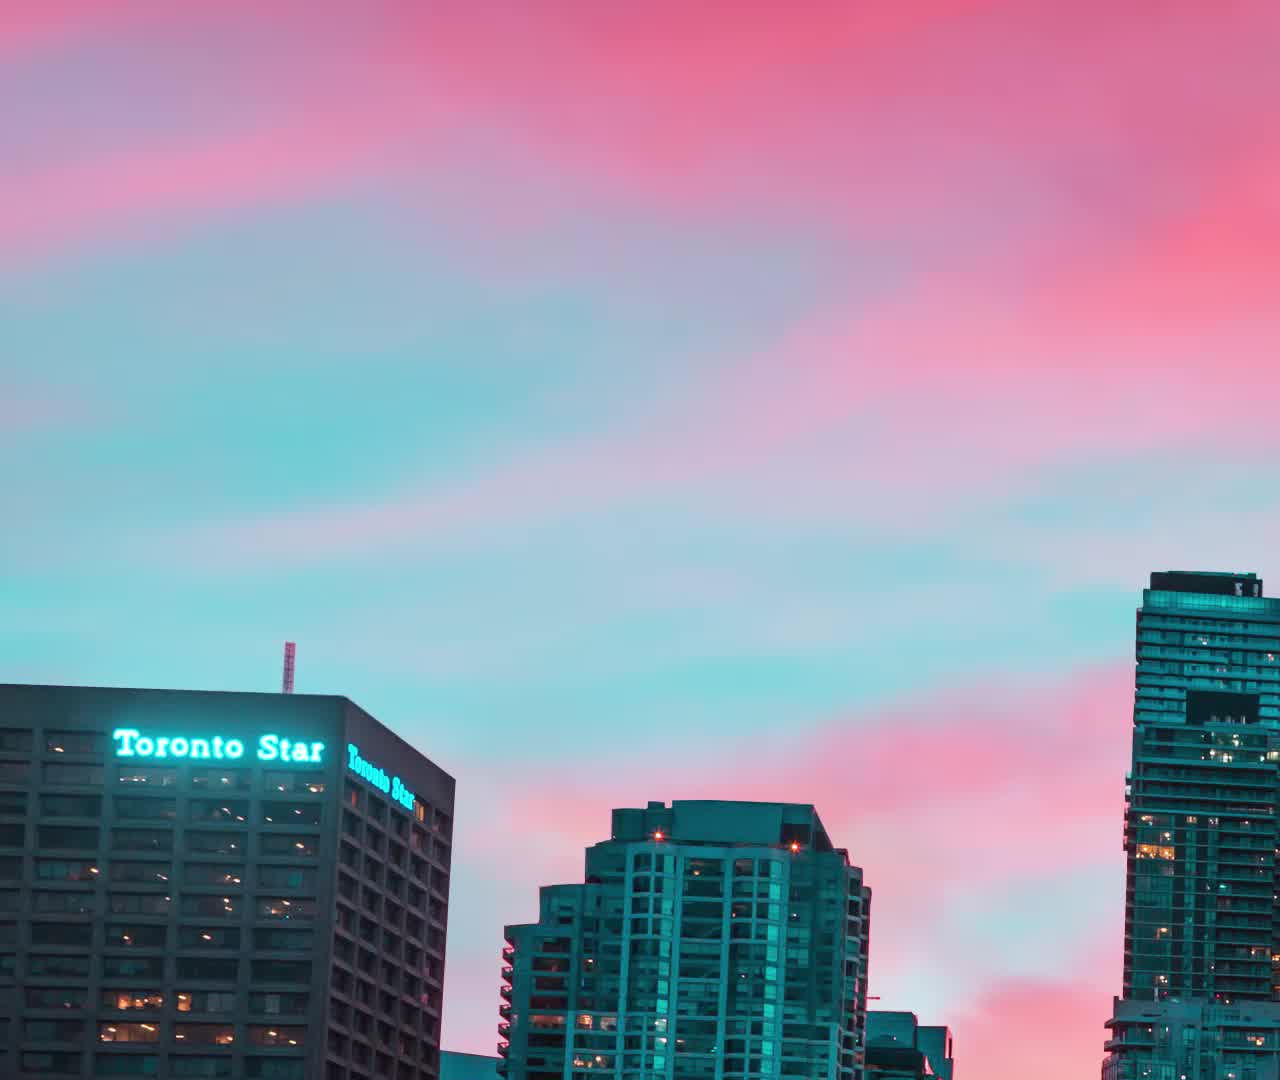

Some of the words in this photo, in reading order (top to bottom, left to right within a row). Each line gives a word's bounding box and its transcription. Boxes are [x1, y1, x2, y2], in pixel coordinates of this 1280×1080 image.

[113, 728, 243, 759] Toronto
[257, 734, 325, 762] Star
[348, 743, 390, 795] Toronto
[391, 777, 416, 811] Star
